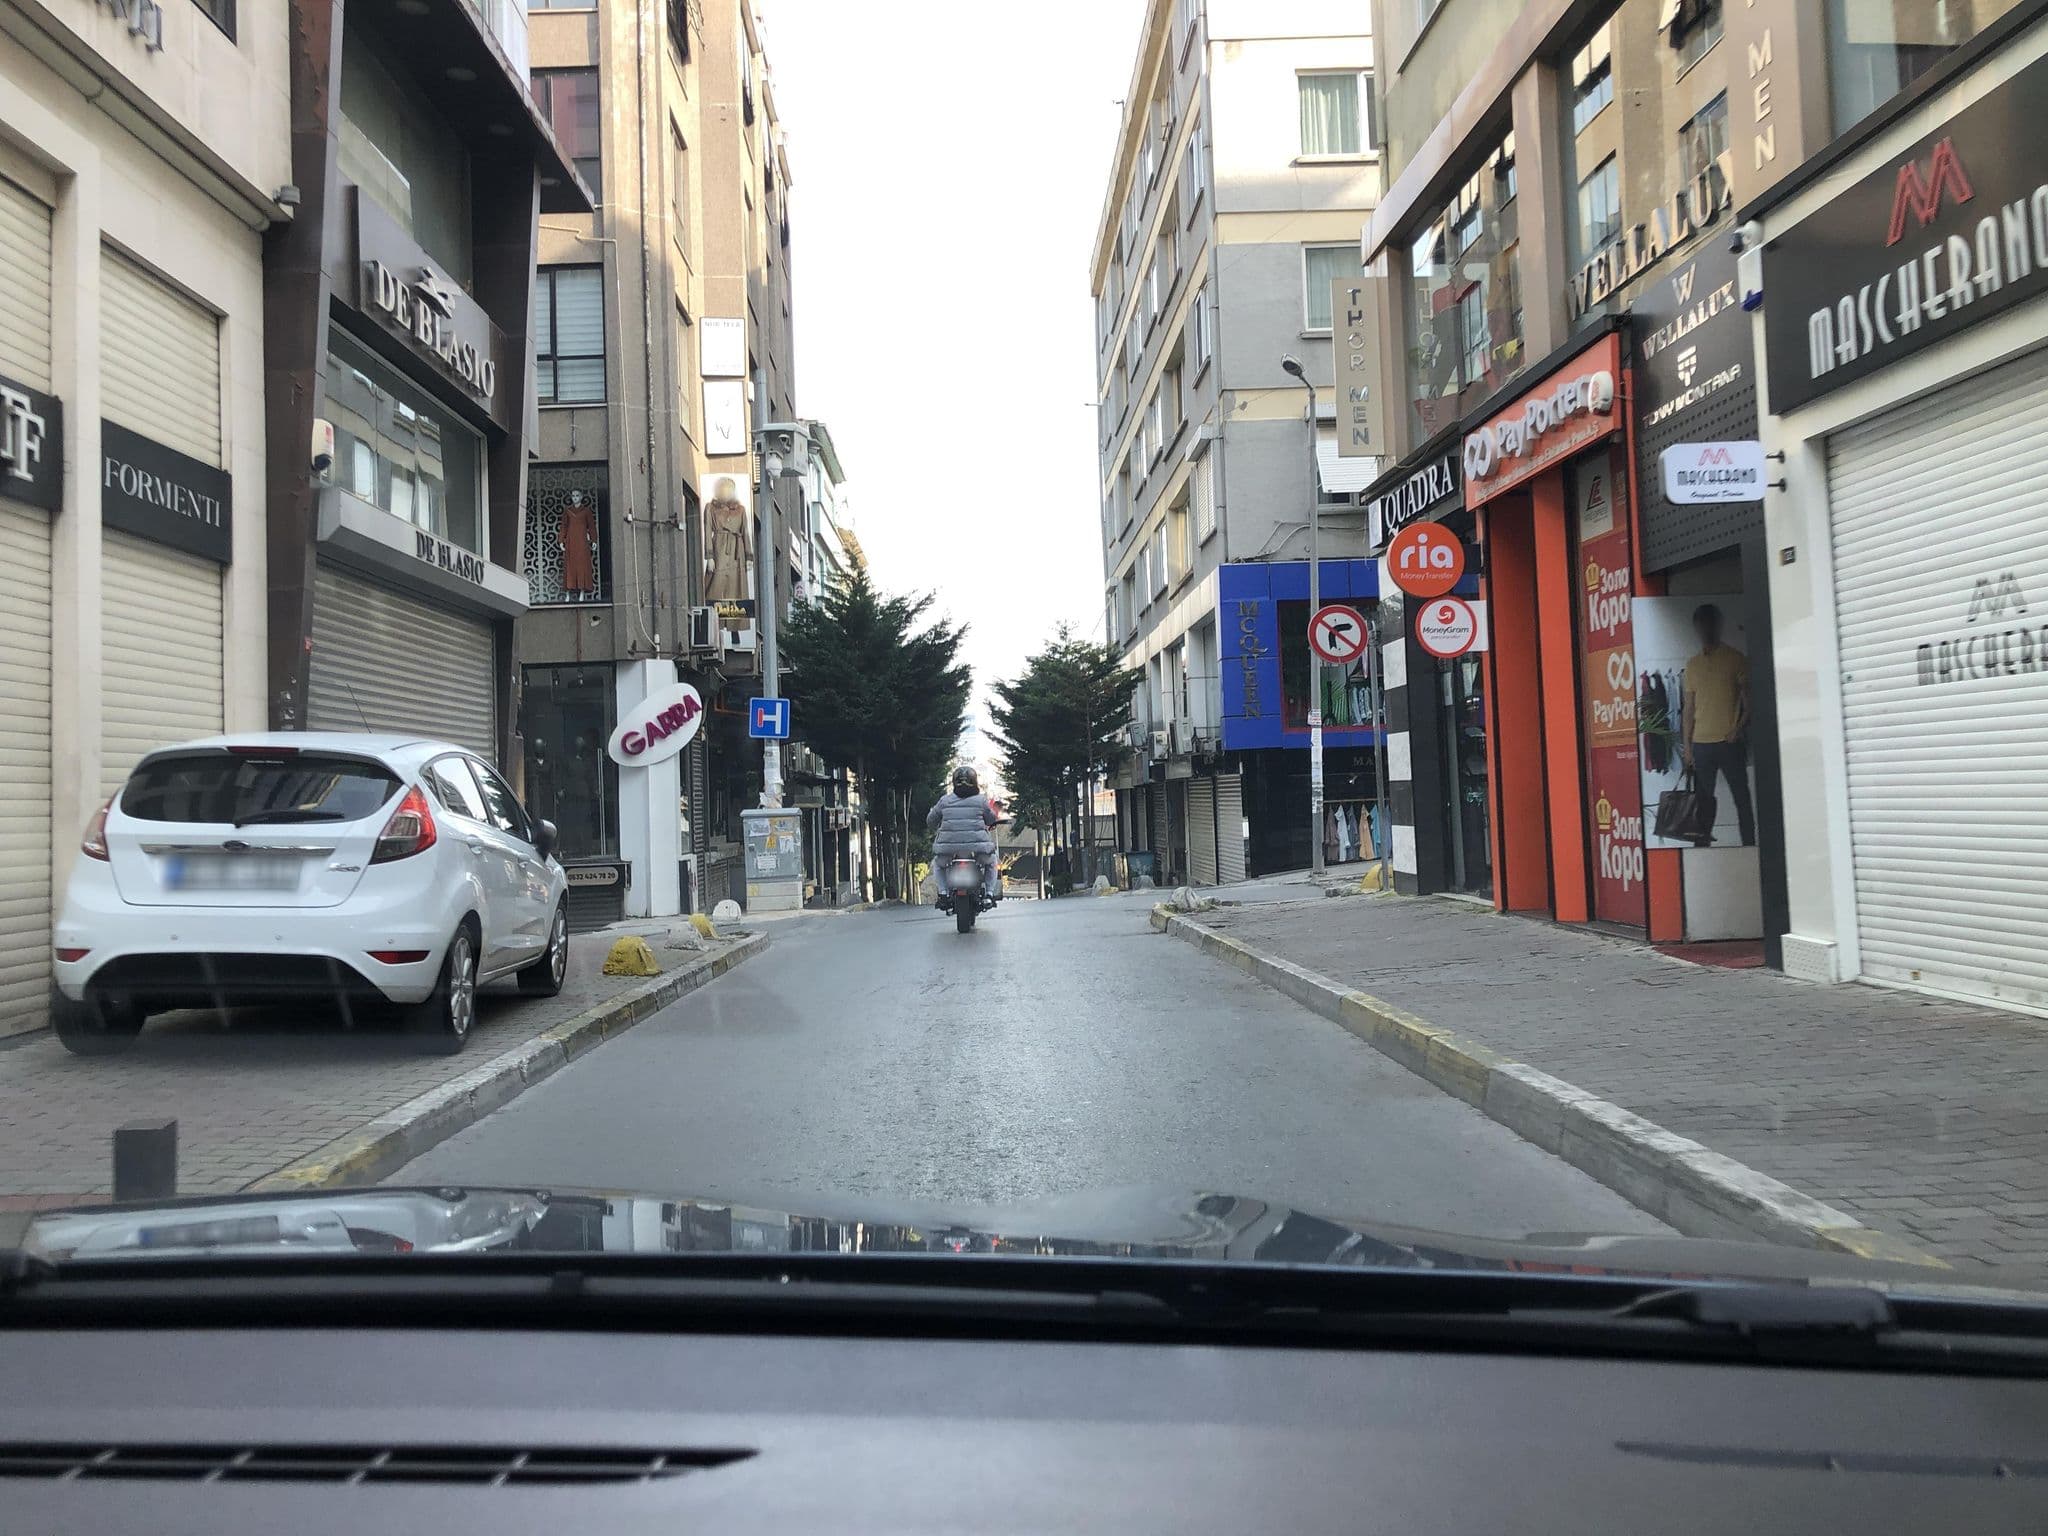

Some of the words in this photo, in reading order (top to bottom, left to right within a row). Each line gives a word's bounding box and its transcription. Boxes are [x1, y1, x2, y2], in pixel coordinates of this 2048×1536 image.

[1748, 26, 1777, 172] MEN
[372, 260, 412, 331] DE
[1345, 287, 1367, 372] THOR
[1349, 384, 1371, 447] MEN
[1495, 377, 1591, 460] PayPorter
[104, 456, 222, 528] FORMENTI
[1384, 456, 1455, 537] QUADRA
[416, 530, 435, 564] DE
[1400, 533, 1454, 569] ria
[1600, 566, 1631, 594] Золо
[1423, 626, 1471, 635] MoneyGram
[1589, 591, 1632, 637] Коро
[621, 694, 702, 756] GARRA
